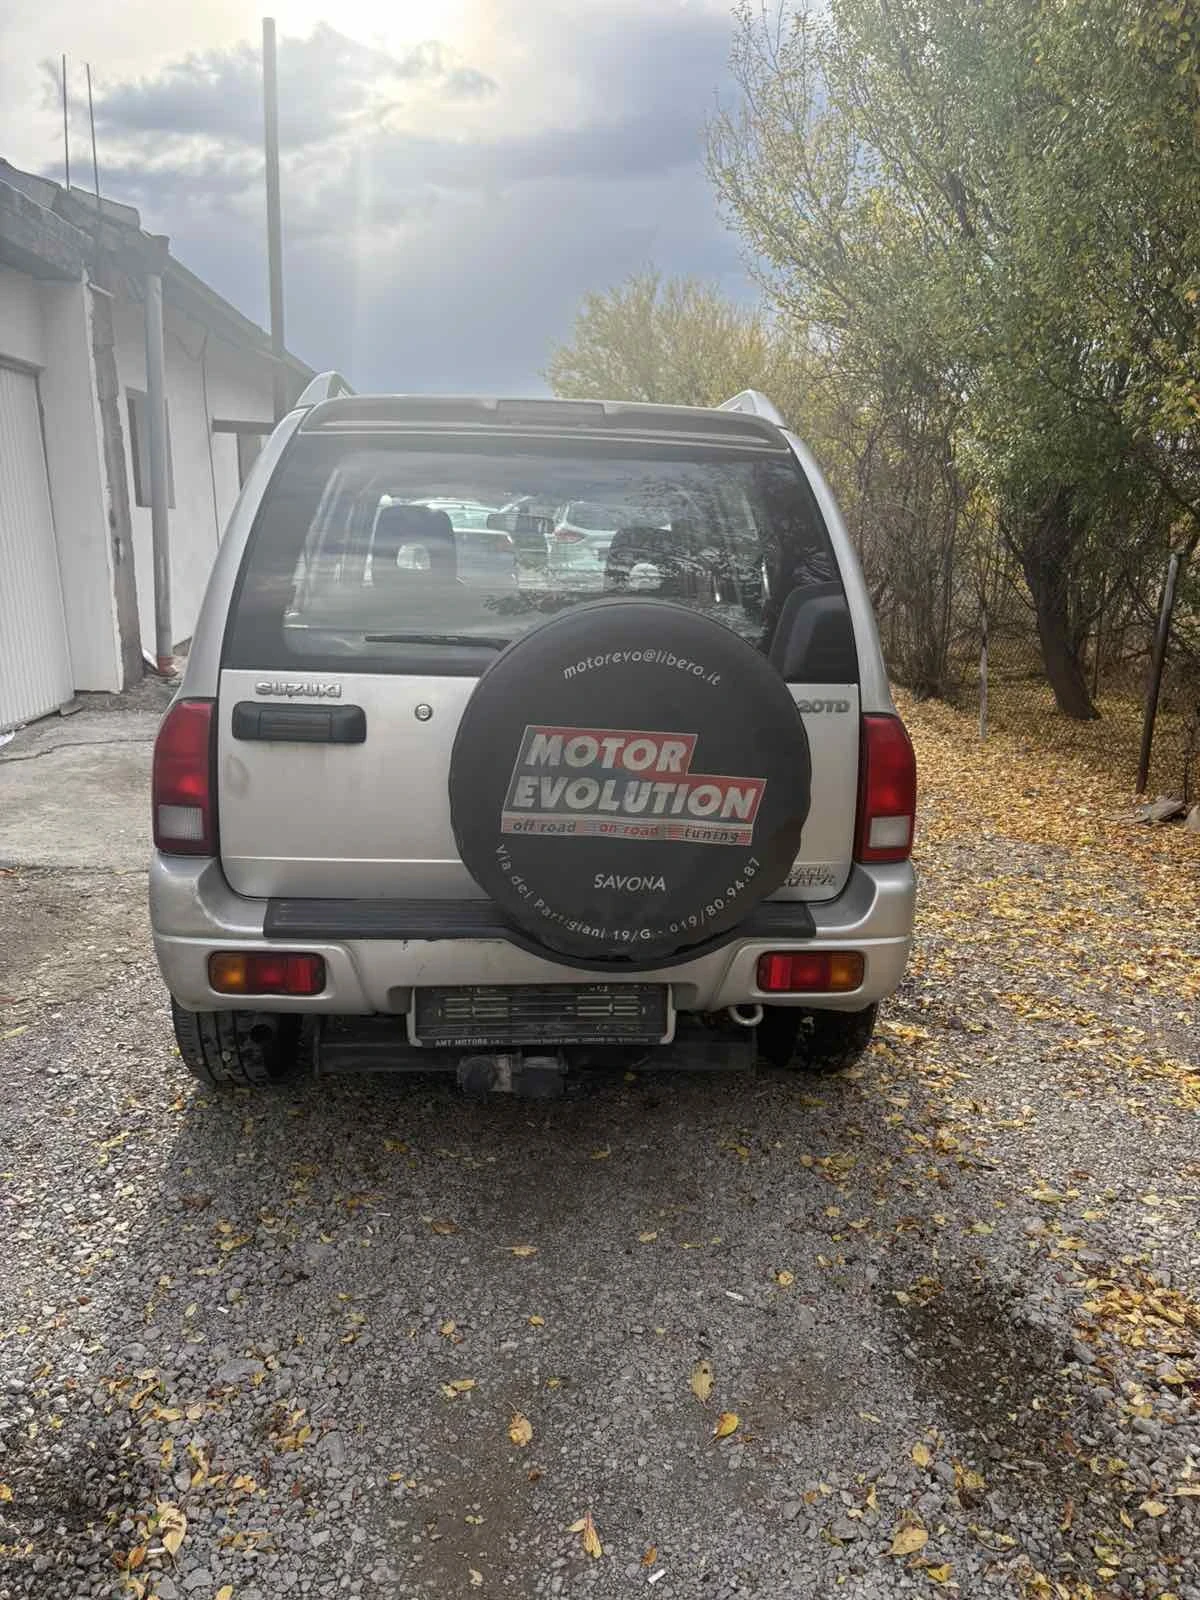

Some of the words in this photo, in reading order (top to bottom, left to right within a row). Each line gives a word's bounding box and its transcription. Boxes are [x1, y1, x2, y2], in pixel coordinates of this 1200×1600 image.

[563, 648, 721, 686] motorevo@libero.it
[255, 680, 342, 698] SUZUKI
[525, 732, 688, 773] MOTOR
[512, 774, 758, 819] EVOLUTION
[540, 821, 577, 833] road
[599, 823, 617, 833] on
[623, 824, 659, 837] road
[685, 824, 741, 844] tuning
[592, 872, 667, 892] SAVONA
[533, 897, 606, 939] Partigiani
[613, 928, 651, 943] 19/G
